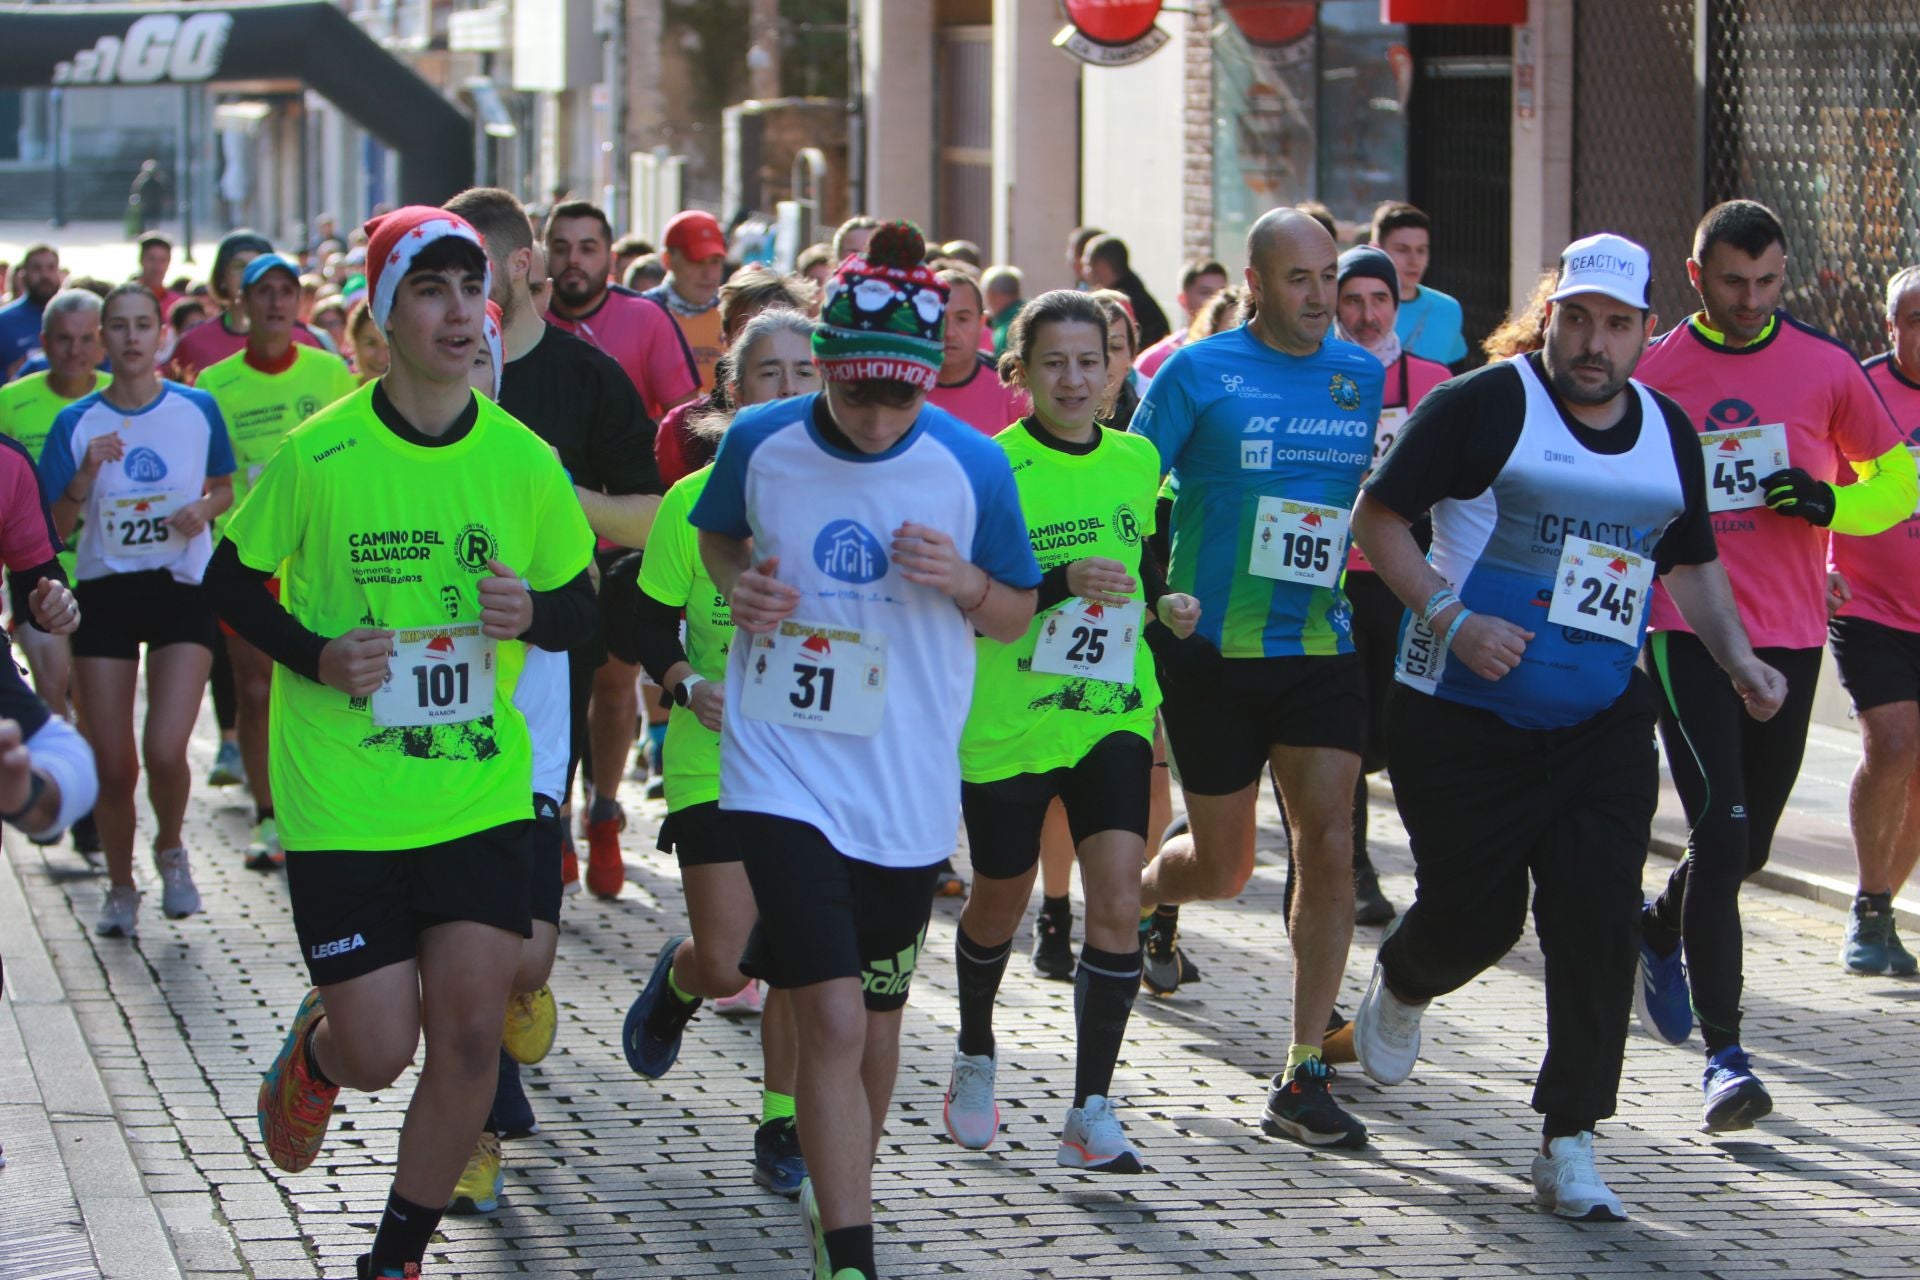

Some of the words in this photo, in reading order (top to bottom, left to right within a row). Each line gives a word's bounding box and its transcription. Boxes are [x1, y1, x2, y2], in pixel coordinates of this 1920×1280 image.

[1242, 416, 1281, 434] DC
[1286, 417, 1368, 437] LUANCO
[313, 442, 346, 463] luanvi
[1245, 446, 1269, 464] nf
[1277, 448, 1368, 466] consultores
[1713, 459, 1757, 495] 45
[121, 517, 169, 546] 225
[349, 530, 408, 548] CAMINO
[412, 530, 444, 546] DEL
[1029, 521, 1077, 539] AMINO
[1078, 517, 1105, 532] DEL
[1031, 532, 1098, 551] ALVADOR
[350, 546, 430, 563] SALVADOR
[1282, 532, 1332, 572] 195
[1577, 577, 1637, 626] 245
[1066, 626, 1108, 664] 25
[1406, 617, 1434, 678] CEAC
[412, 663, 469, 708] 101
[789, 663, 835, 711] 31
[312, 933, 366, 959] LEGEA
